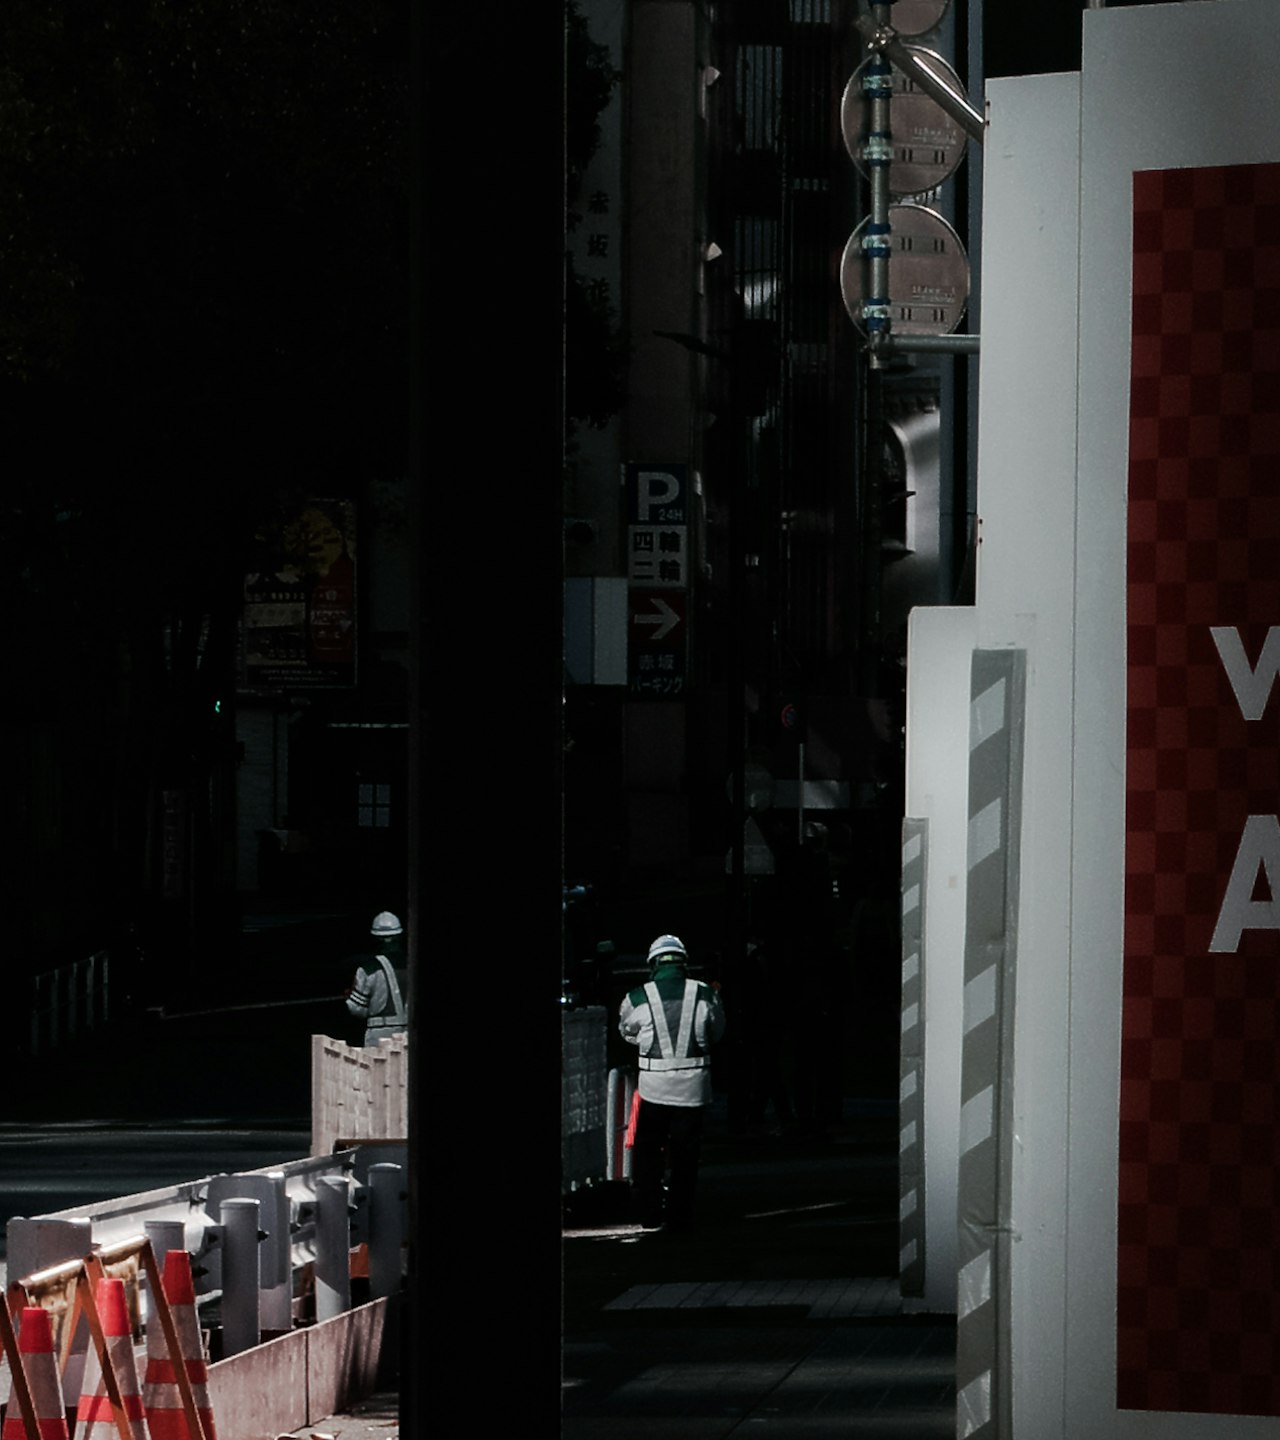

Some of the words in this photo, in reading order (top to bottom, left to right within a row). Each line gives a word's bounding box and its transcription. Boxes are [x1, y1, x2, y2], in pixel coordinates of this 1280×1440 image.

[638, 472, 680, 521] P
[658, 509, 684, 522] 24H
[634, 531, 681, 553] 四輪
[634, 559, 681, 582] 二輪
[639, 654, 675, 671] 赤坂
[631, 674, 684, 694] パーキング
